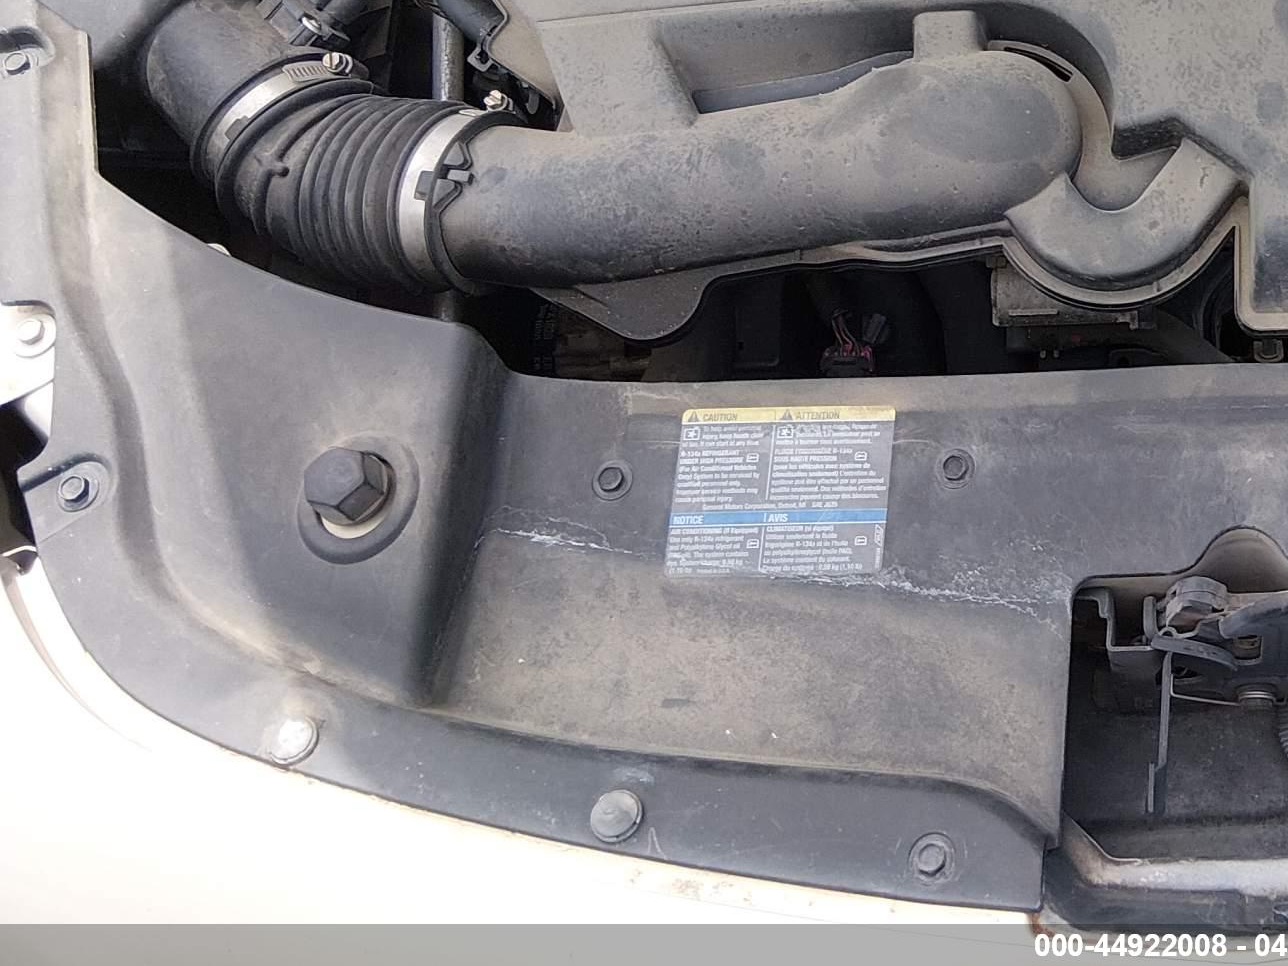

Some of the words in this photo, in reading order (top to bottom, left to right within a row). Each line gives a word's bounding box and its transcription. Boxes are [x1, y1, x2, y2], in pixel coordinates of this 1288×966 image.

[703, 413, 737, 421] CAUTION
[796, 411, 840, 419] ATTENTION
[673, 515, 704, 524] NOTICE
[768, 513, 788, 522] AVIS
